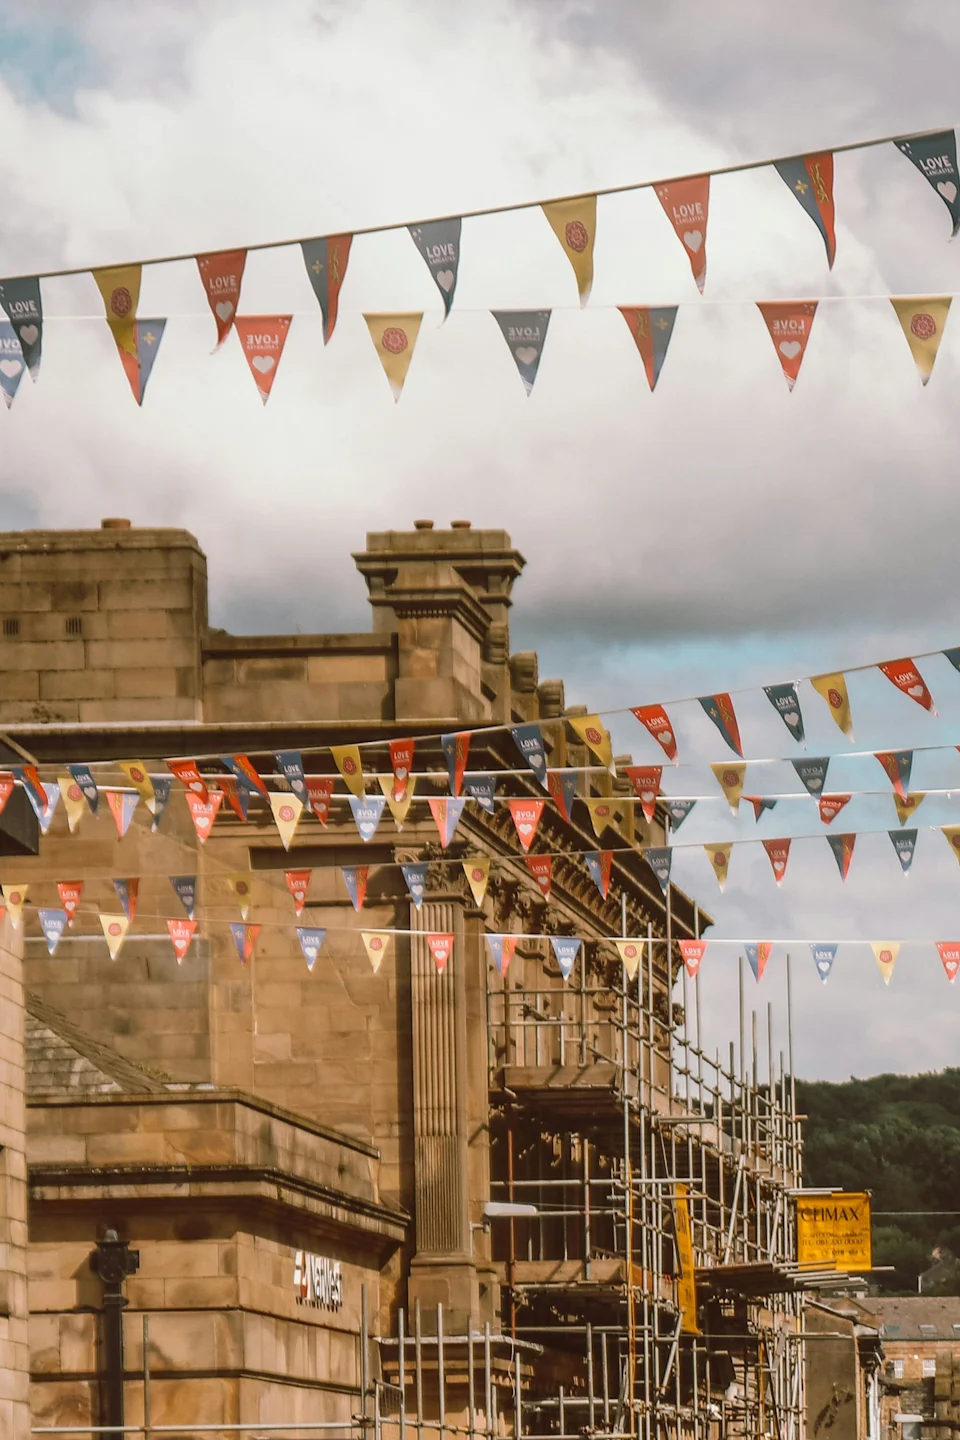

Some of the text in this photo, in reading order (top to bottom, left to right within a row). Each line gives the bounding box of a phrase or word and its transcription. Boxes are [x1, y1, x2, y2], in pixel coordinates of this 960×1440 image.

[919, 155, 951, 171] LOVE
[673, 202, 703, 218] LOVE
[426, 243, 455, 259] LOVE
[209, 275, 237, 289] LOVE
[9, 301, 37, 313] LOVE
[895, 672, 914, 683] LOVE
[776, 696, 793, 706] LOVE
[647, 717, 666, 727] LOVE
[520, 739, 539, 748] LOVE
[393, 751, 409, 760] LOVE
[177, 770, 196, 778] LOVE
[284, 765, 300, 773] LOVE
[75, 774, 91, 782] LOVE
[801, 1207, 859, 1221] CLIMAX
